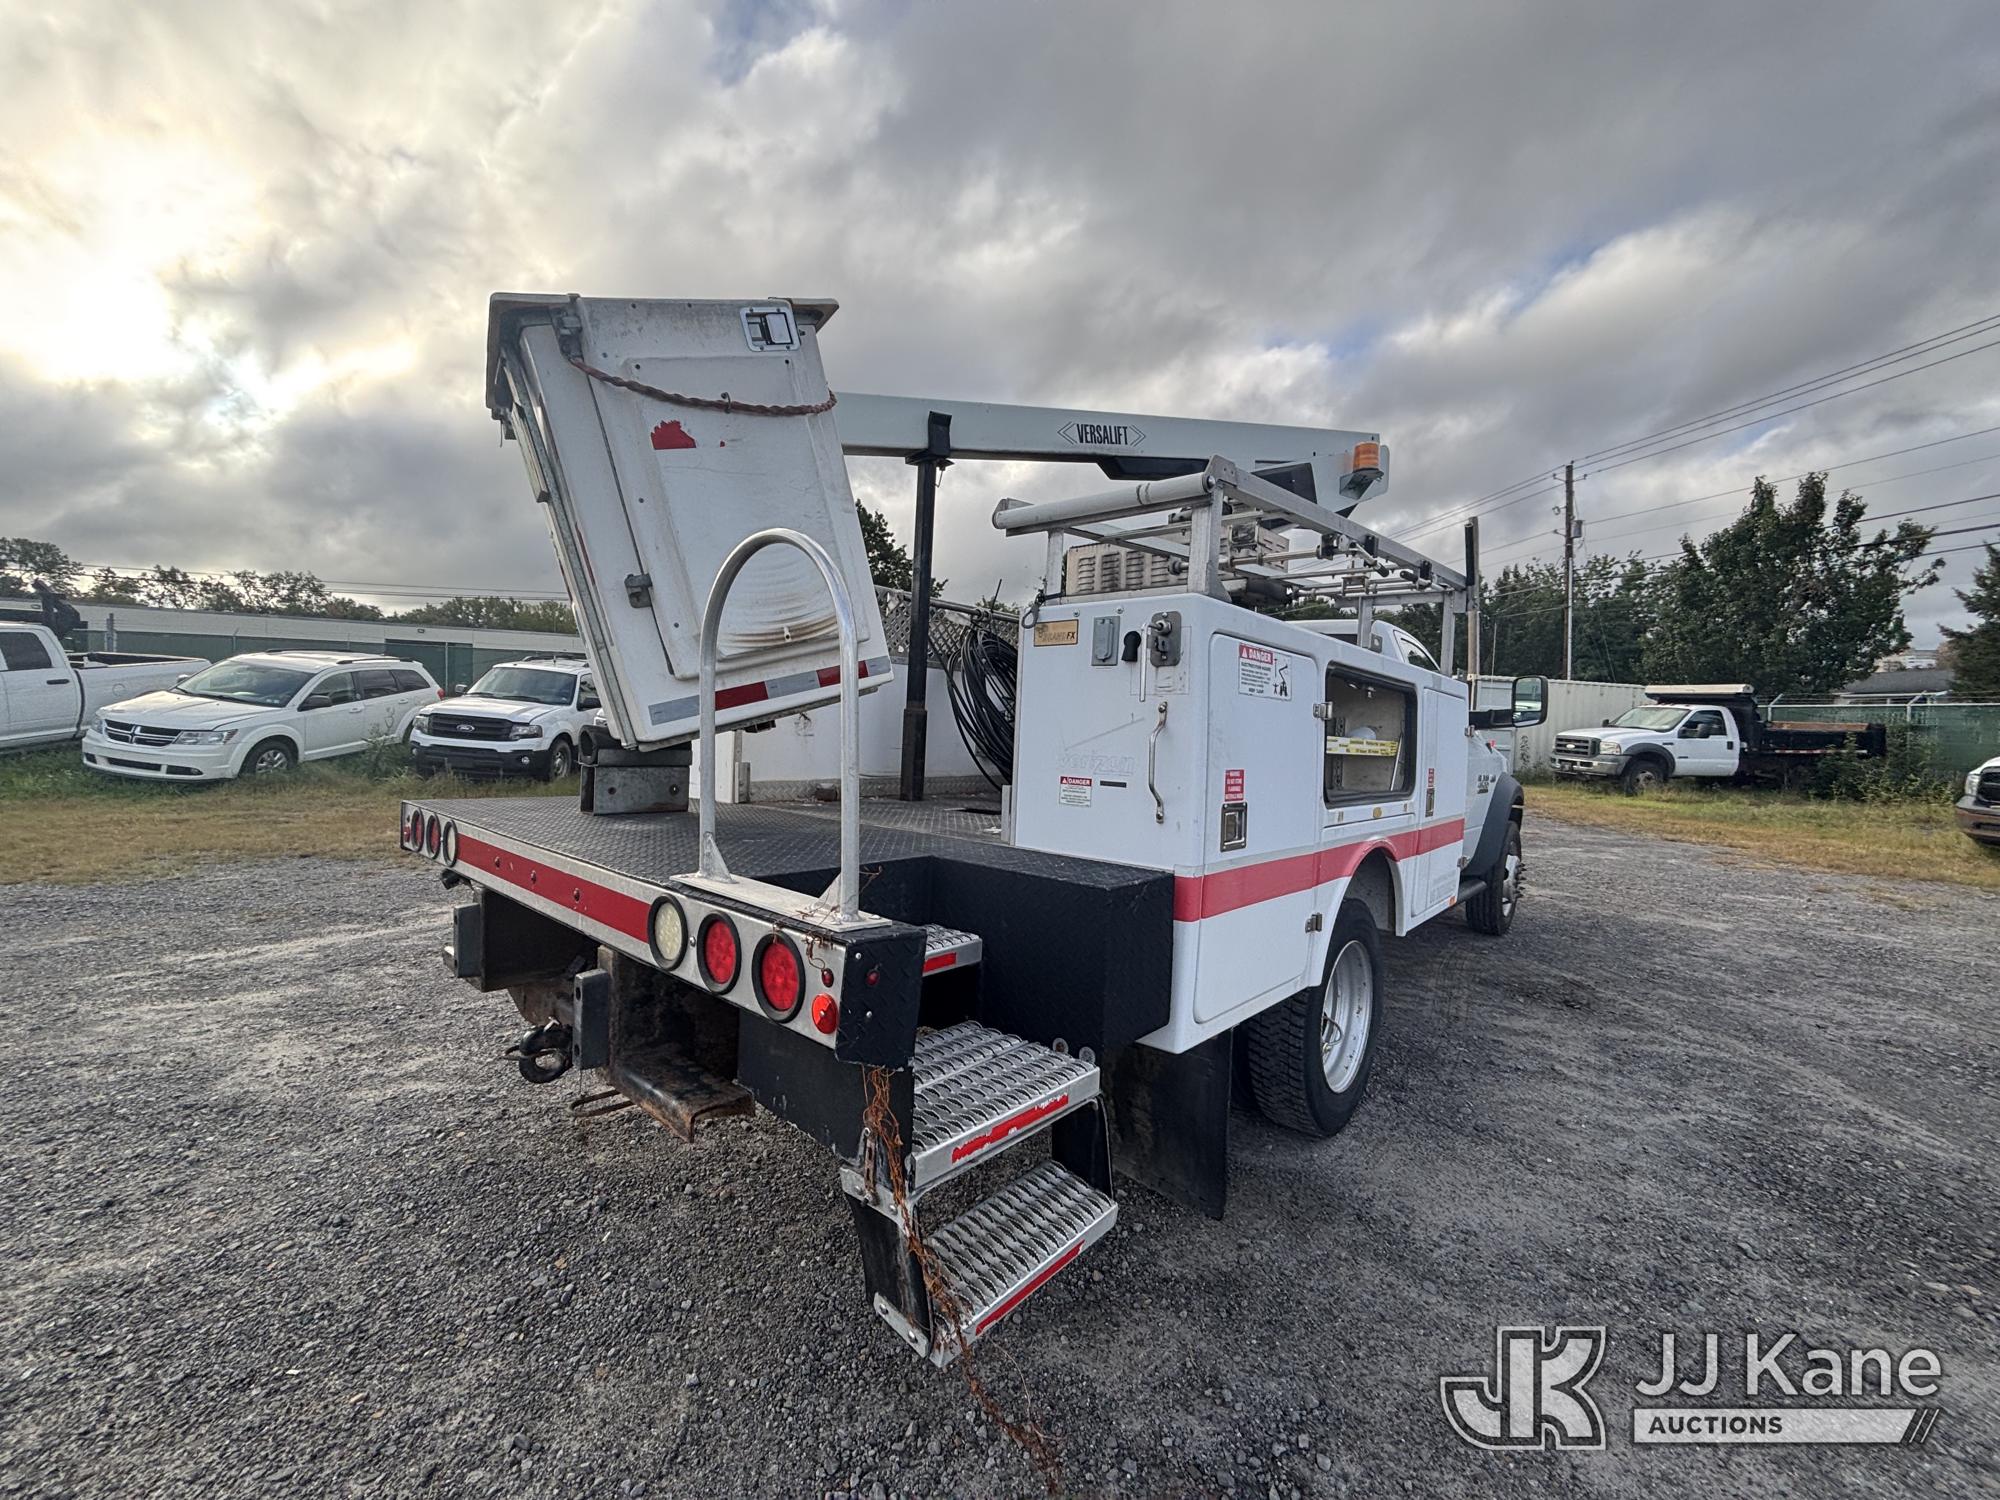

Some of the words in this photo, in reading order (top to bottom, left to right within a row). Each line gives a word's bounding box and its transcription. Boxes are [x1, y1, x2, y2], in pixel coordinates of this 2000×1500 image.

[1076, 423, 1128, 445] VERSALIFT
[1248, 648, 1272, 663] DANGER
[1068, 778, 1091, 786] DANGER
